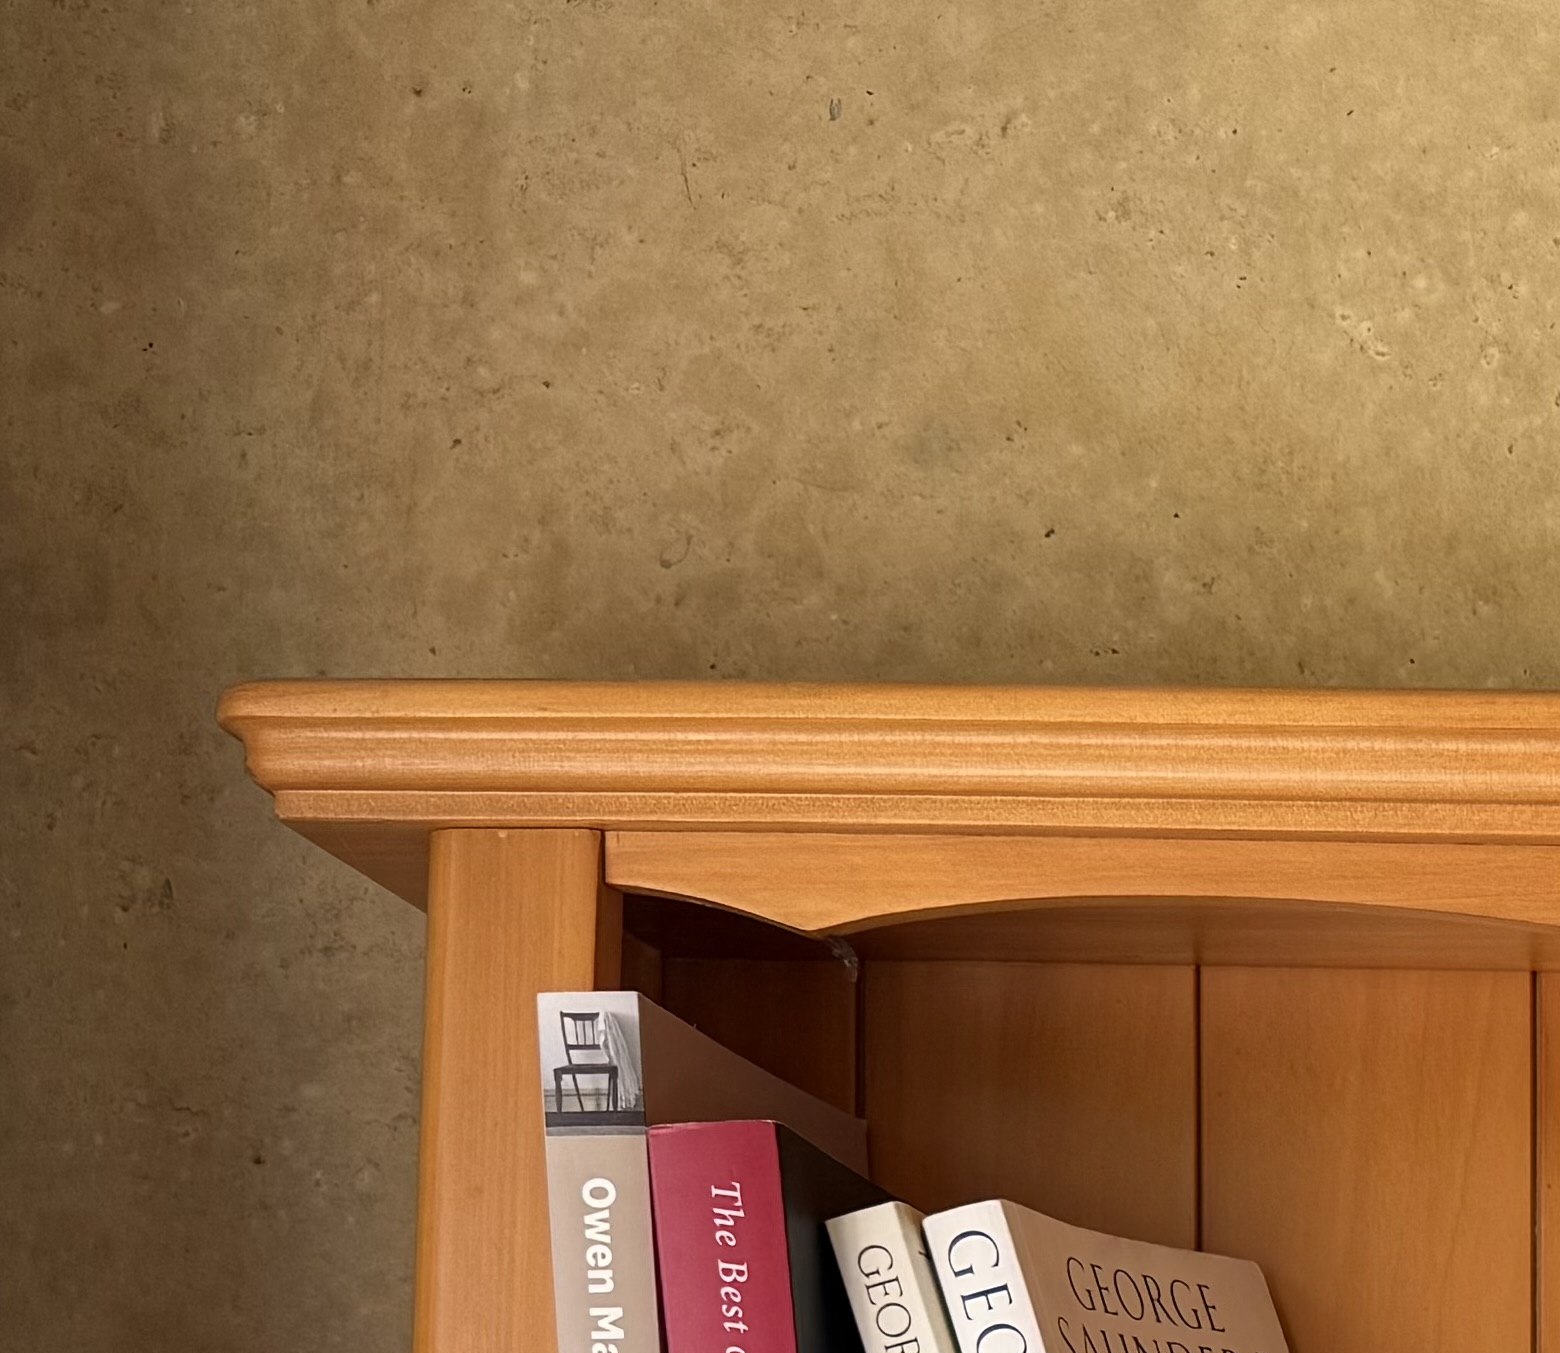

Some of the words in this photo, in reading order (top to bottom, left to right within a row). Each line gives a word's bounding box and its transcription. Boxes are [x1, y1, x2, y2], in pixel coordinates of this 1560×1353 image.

[582, 1177, 617, 1296] Owen
[710, 1181, 747, 1249] The
[717, 1259, 749, 1333] Best
[1066, 1255, 1227, 1334] GEORGE
